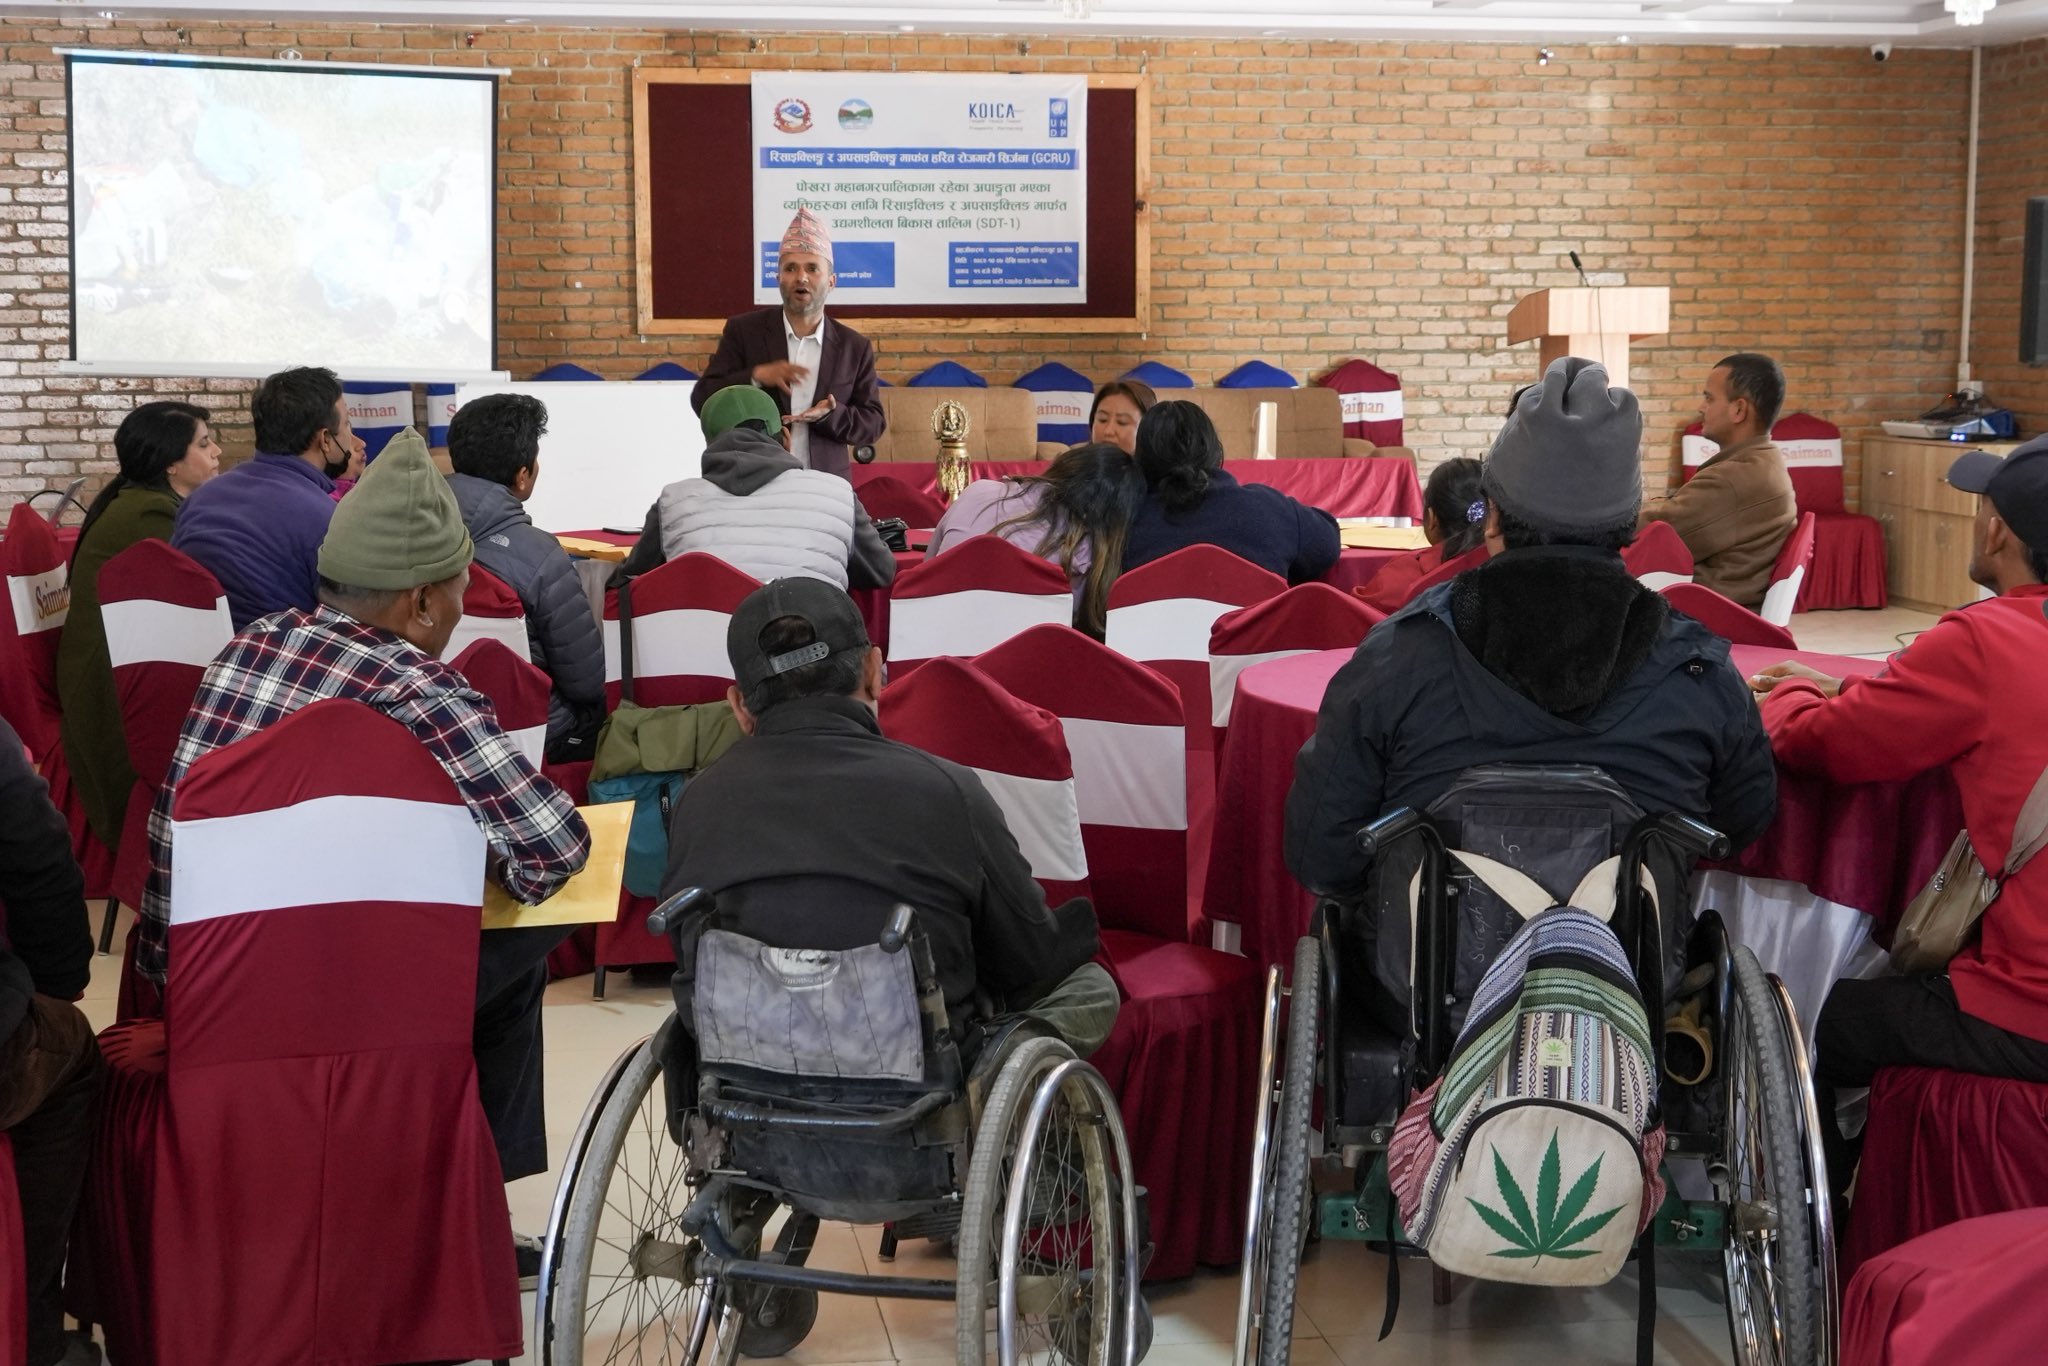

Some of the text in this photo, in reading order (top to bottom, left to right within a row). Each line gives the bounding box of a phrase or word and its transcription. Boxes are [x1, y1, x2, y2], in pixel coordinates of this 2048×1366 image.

[969, 103, 1015, 119] KOICA
[827, 152, 834, 163] र
[931, 150, 955, 164] हरित
[957, 151, 996, 164] रोजगारी
[1031, 151, 1071, 165] (GCRU)
[796, 180, 830, 192] पोखरा
[834, 180, 934, 193] महानगरपालिकामा
[939, 180, 969, 193] रहेका
[1019, 182, 1051, 193] भएका
[851, 198, 878, 211] लागि
[949, 200, 956, 211] र
[832, 216, 893, 229] उद्यमशीलता
[936, 216, 972, 229] तालिम
[976, 217, 1021, 230] (SDT-1)
[349, 403, 398, 418] aiman
[1036, 401, 1081, 417] aiman
[1782, 445, 1833, 461] Saiman
